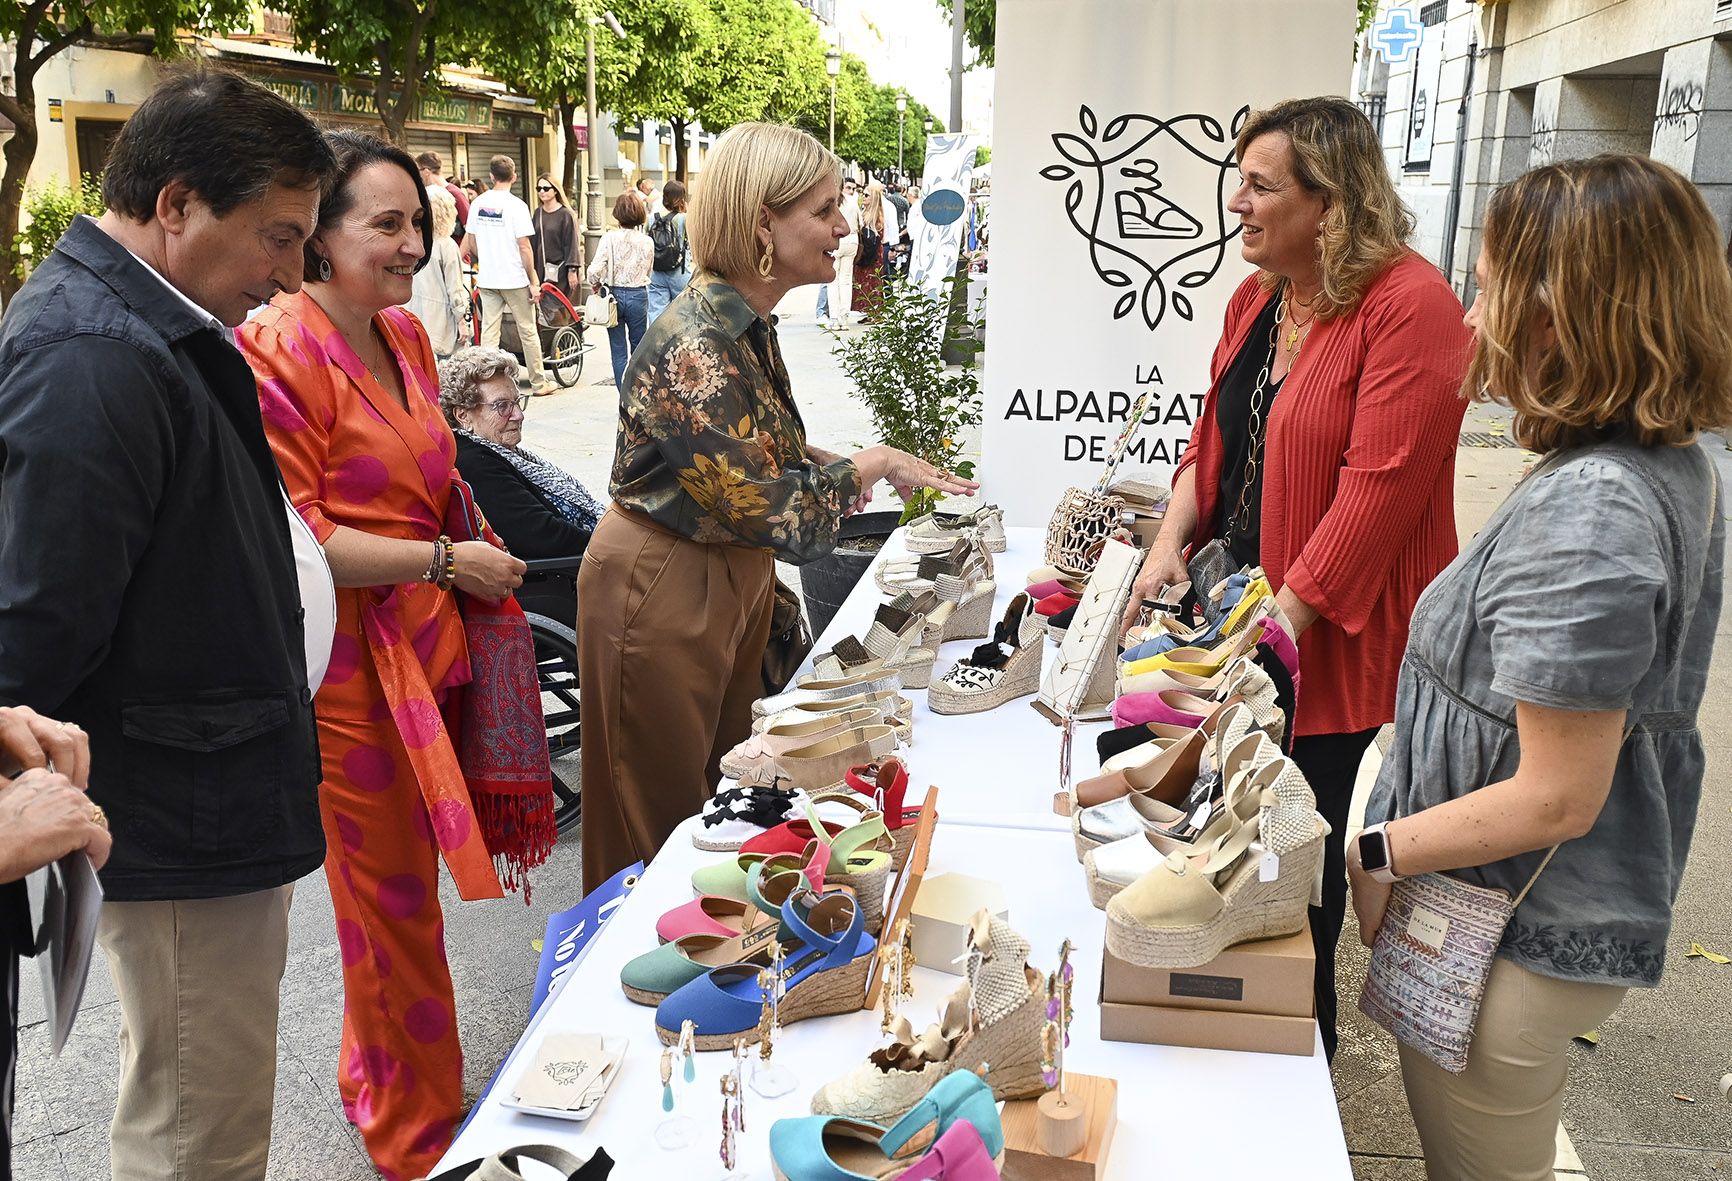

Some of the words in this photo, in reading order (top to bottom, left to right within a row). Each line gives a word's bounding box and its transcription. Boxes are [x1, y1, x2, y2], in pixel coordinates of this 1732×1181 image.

[423, 100, 466, 121] REGALOS
[1135, 364, 1164, 385] LA
[1064, 434, 1107, 463] DE
